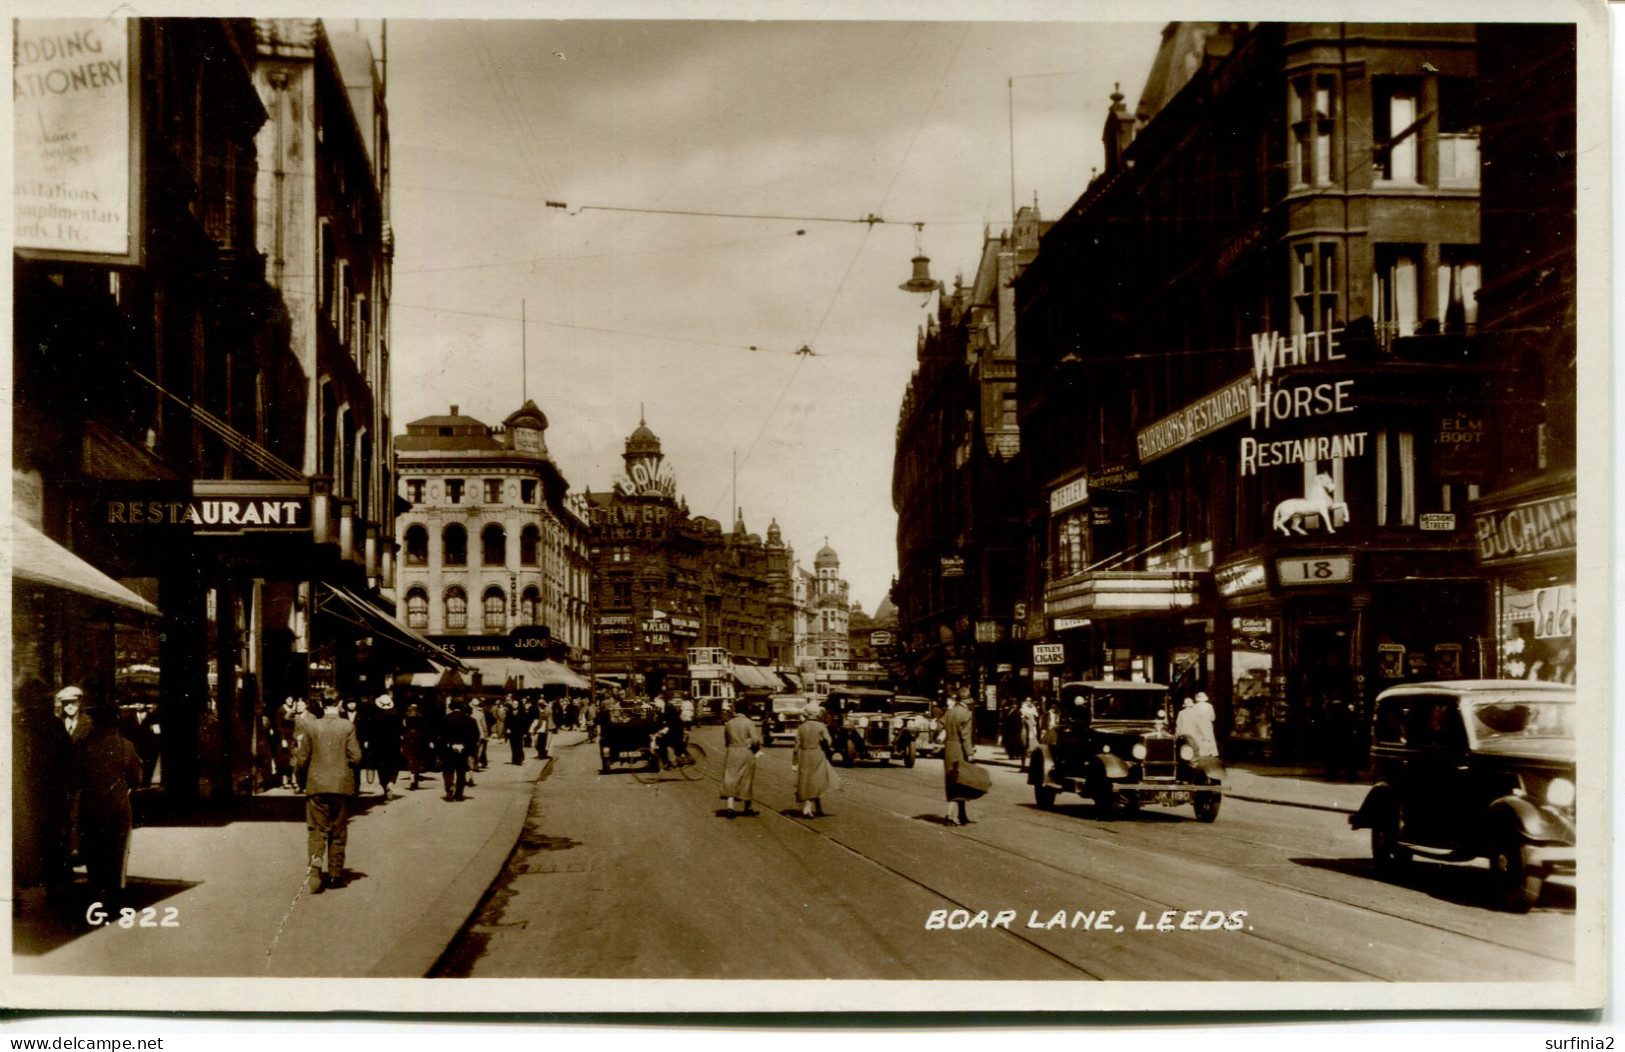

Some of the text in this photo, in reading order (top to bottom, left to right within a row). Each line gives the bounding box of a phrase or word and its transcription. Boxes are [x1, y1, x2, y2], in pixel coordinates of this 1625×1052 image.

[15, 29, 102, 64] DDING
[1251, 328, 1347, 380] WHITE
[1185, 378, 1252, 437] RESTAURANT
[1251, 380, 1355, 431] HORSE
[1240, 431, 1368, 477] RESTAURANT
[1440, 431, 1486, 443] BOOT
[107, 500, 302, 525] RESTAURANT
[1302, 561, 1332, 578] 18
[1535, 587, 1570, 637] Sale
[1034, 653, 1064, 663] CIGARS
